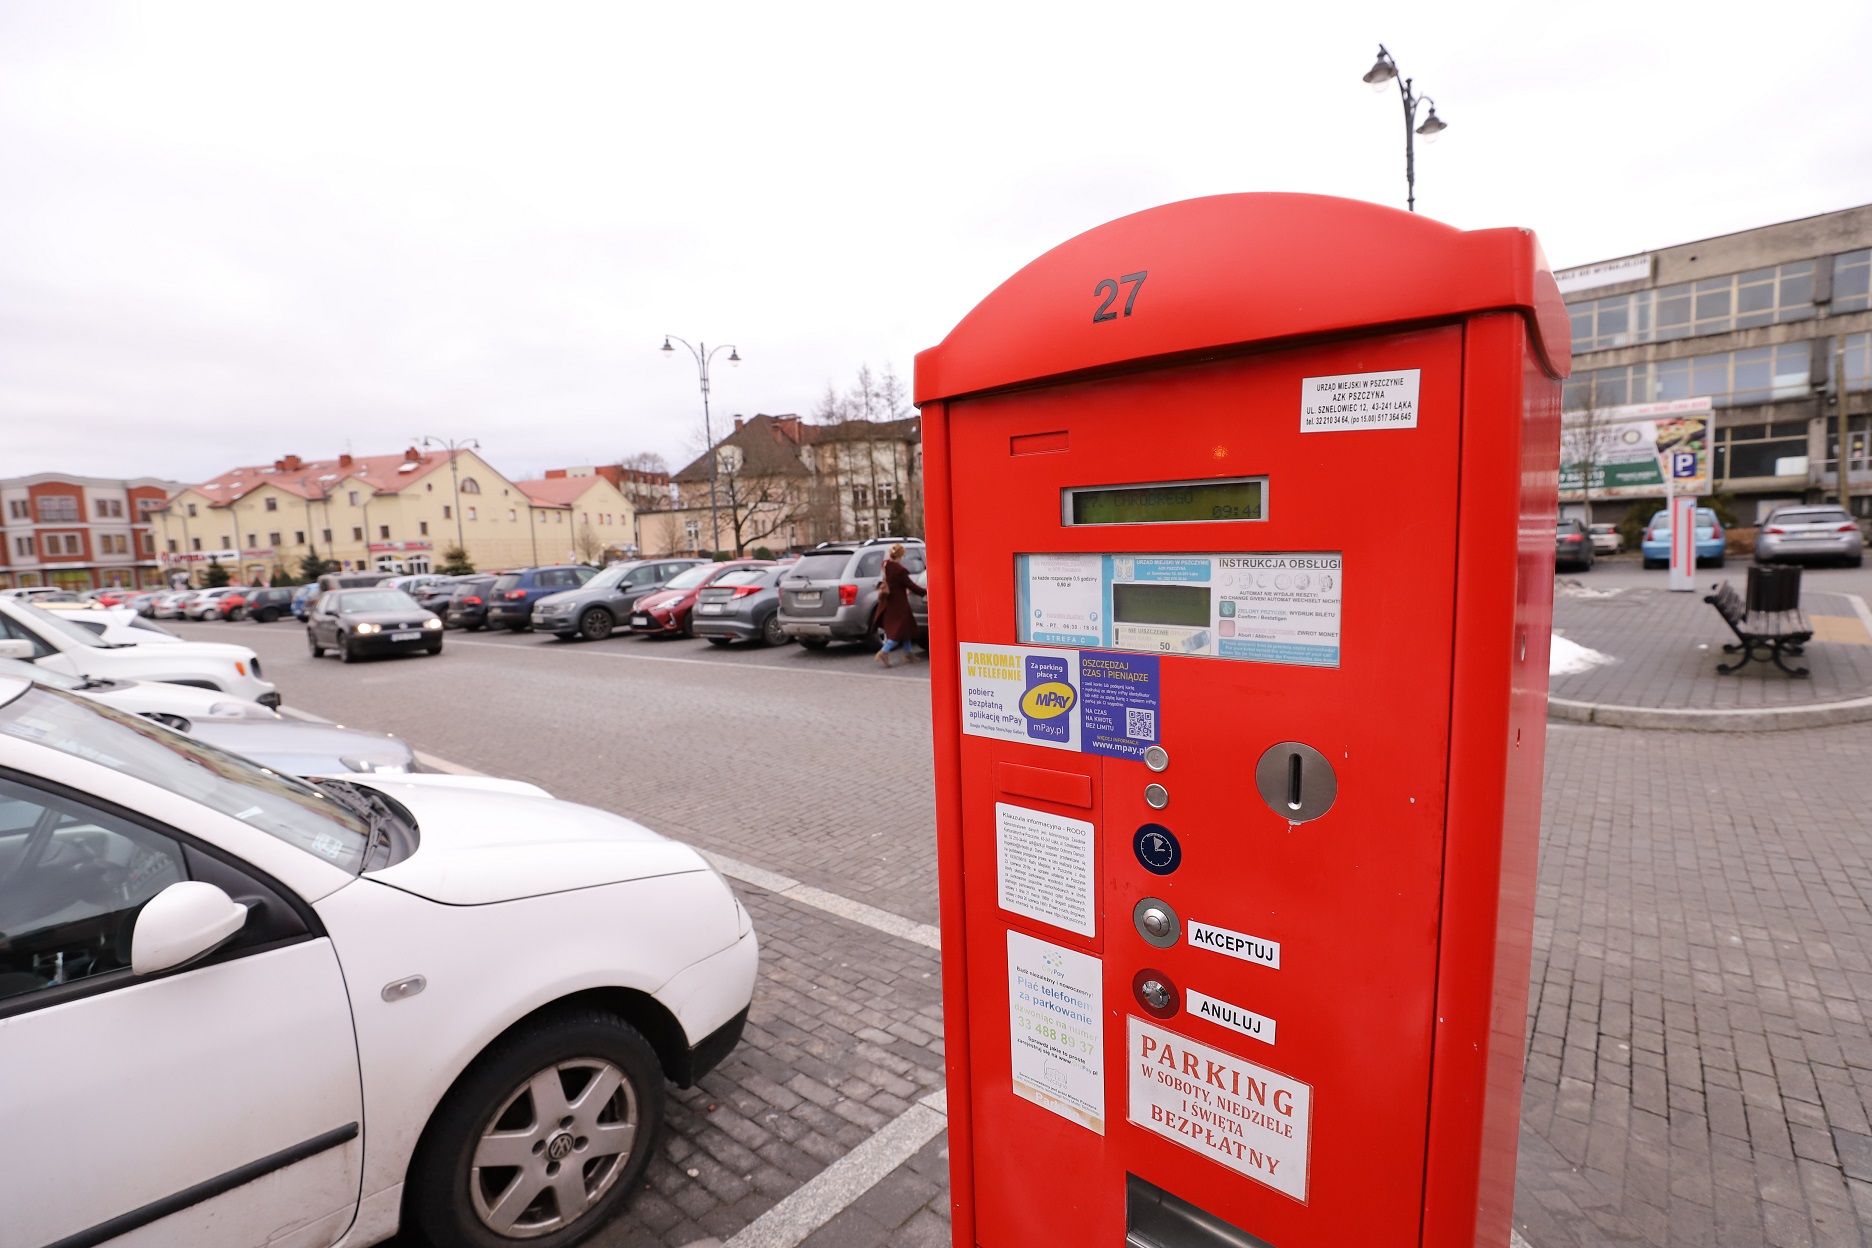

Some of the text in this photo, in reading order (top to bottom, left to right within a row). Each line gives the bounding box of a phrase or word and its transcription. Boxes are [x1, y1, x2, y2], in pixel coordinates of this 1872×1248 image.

[1093, 270, 1147, 324] 27
[1317, 378, 1404, 392] URZĄD MIEJSKI W PSZCZYNIE
[1333, 391, 1384, 401] AZK PSZCZYNA
[1307, 401, 1412, 414] UL. SZNELOWIEC 12, 43-241 ŁĄKA
[1306, 417, 1314, 425] tel.
[1389, 413, 1399, 421] 364
[1401, 412, 1411, 420] 645
[1676, 455, 1693, 472] P
[1212, 504, 1261, 518] 09:44
[1219, 559, 1340, 568] INSTRUKCJA OBSŁUGI
[1160, 642, 1170, 650] 50
[967, 652, 1021, 668] PARKOMAT
[1082, 659, 1129, 670] OSZCZĘDZAJ
[968, 666, 1021, 681] W TELEFONIE
[1037, 671, 1052, 679] płacę
[1040, 664, 1063, 672] parking
[1082, 669, 1101, 677] CZAS
[1108, 671, 1148, 682] PIENIĄDZE
[969, 688, 994, 697] pobierz
[969, 698, 1003, 711] bezpłatną
[970, 711, 1022, 726] aplikację mPay
[1034, 724, 1064, 734] mPay.pl
[1092, 741, 1147, 755] www.mpay.pl
[1003, 812, 1086, 836] Klauzula informacyjna RODO
[1194, 928, 1273, 961] AKCEPTUJ
[1018, 976, 1093, 1011] Płać telefonem
[1020, 991, 1092, 1025] za parkowanie
[1015, 1003, 1098, 1041] dzwoniąc na numer
[1200, 1001, 1260, 1033] ANULUJ
[1018, 1016, 1094, 1055] 33 488 89 37
[1141, 1034, 1293, 1118] PARKING
[1141, 1063, 1293, 1139] W SOBOTY, NIEDZIELE
[1183, 1100, 1243, 1138] I ŚWIĘTA
[1151, 1103, 1280, 1176] BEZPŁATNY
